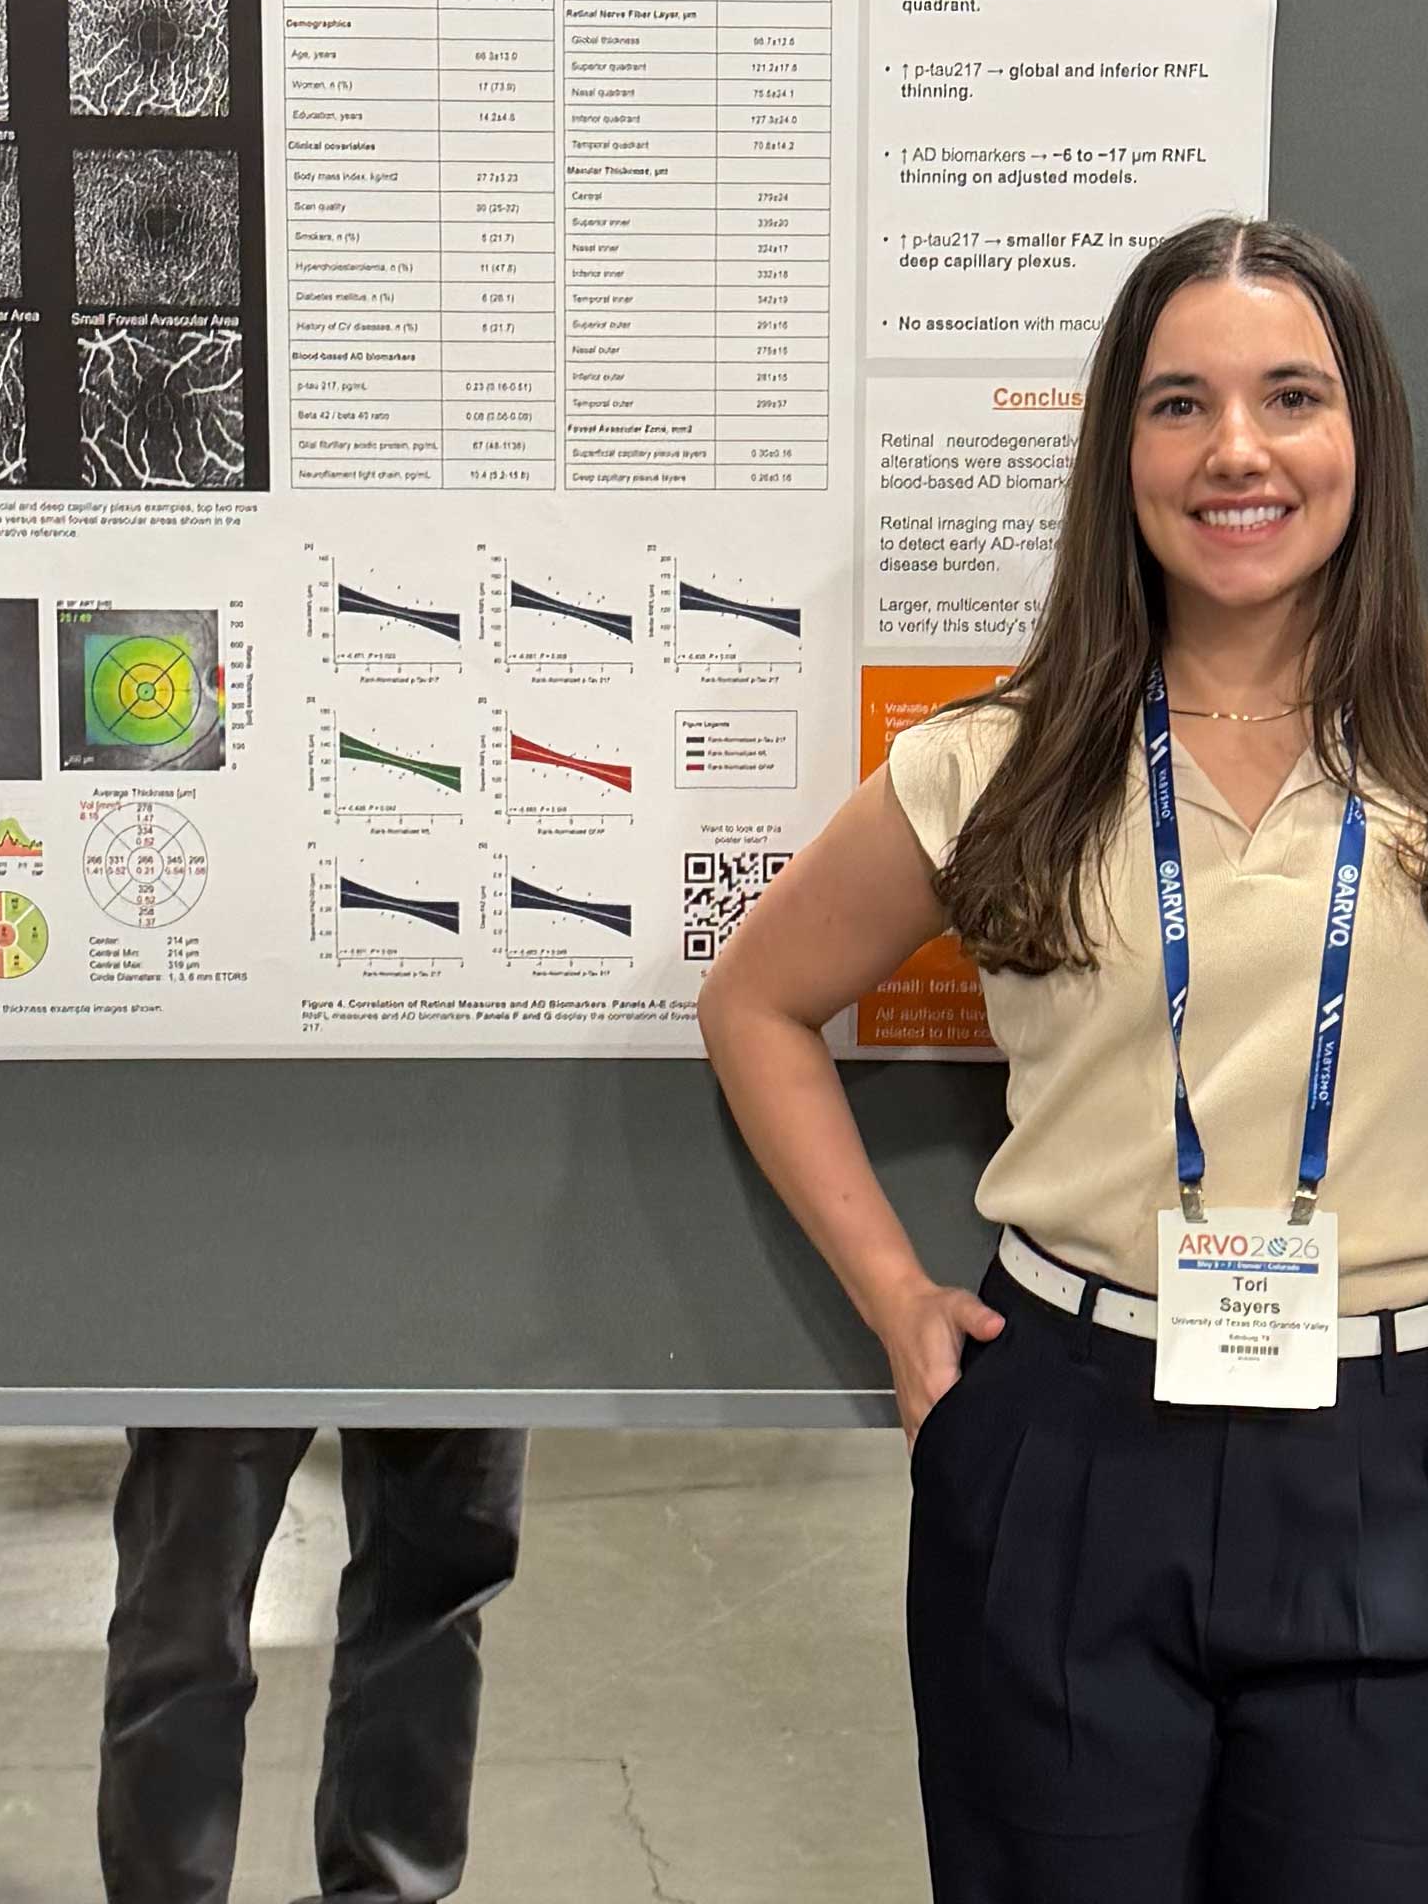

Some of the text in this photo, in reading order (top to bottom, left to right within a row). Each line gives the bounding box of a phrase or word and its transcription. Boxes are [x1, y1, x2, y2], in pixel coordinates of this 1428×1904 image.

[915, 62, 1208, 80] p-tau217 global and inferior RNFL
[901, 83, 972, 101] thinning.
[1178, 1234, 1248, 1257] ARVO
[1233, 1276, 1268, 1292] Tori
[1220, 1297, 1281, 1316] Sayers
